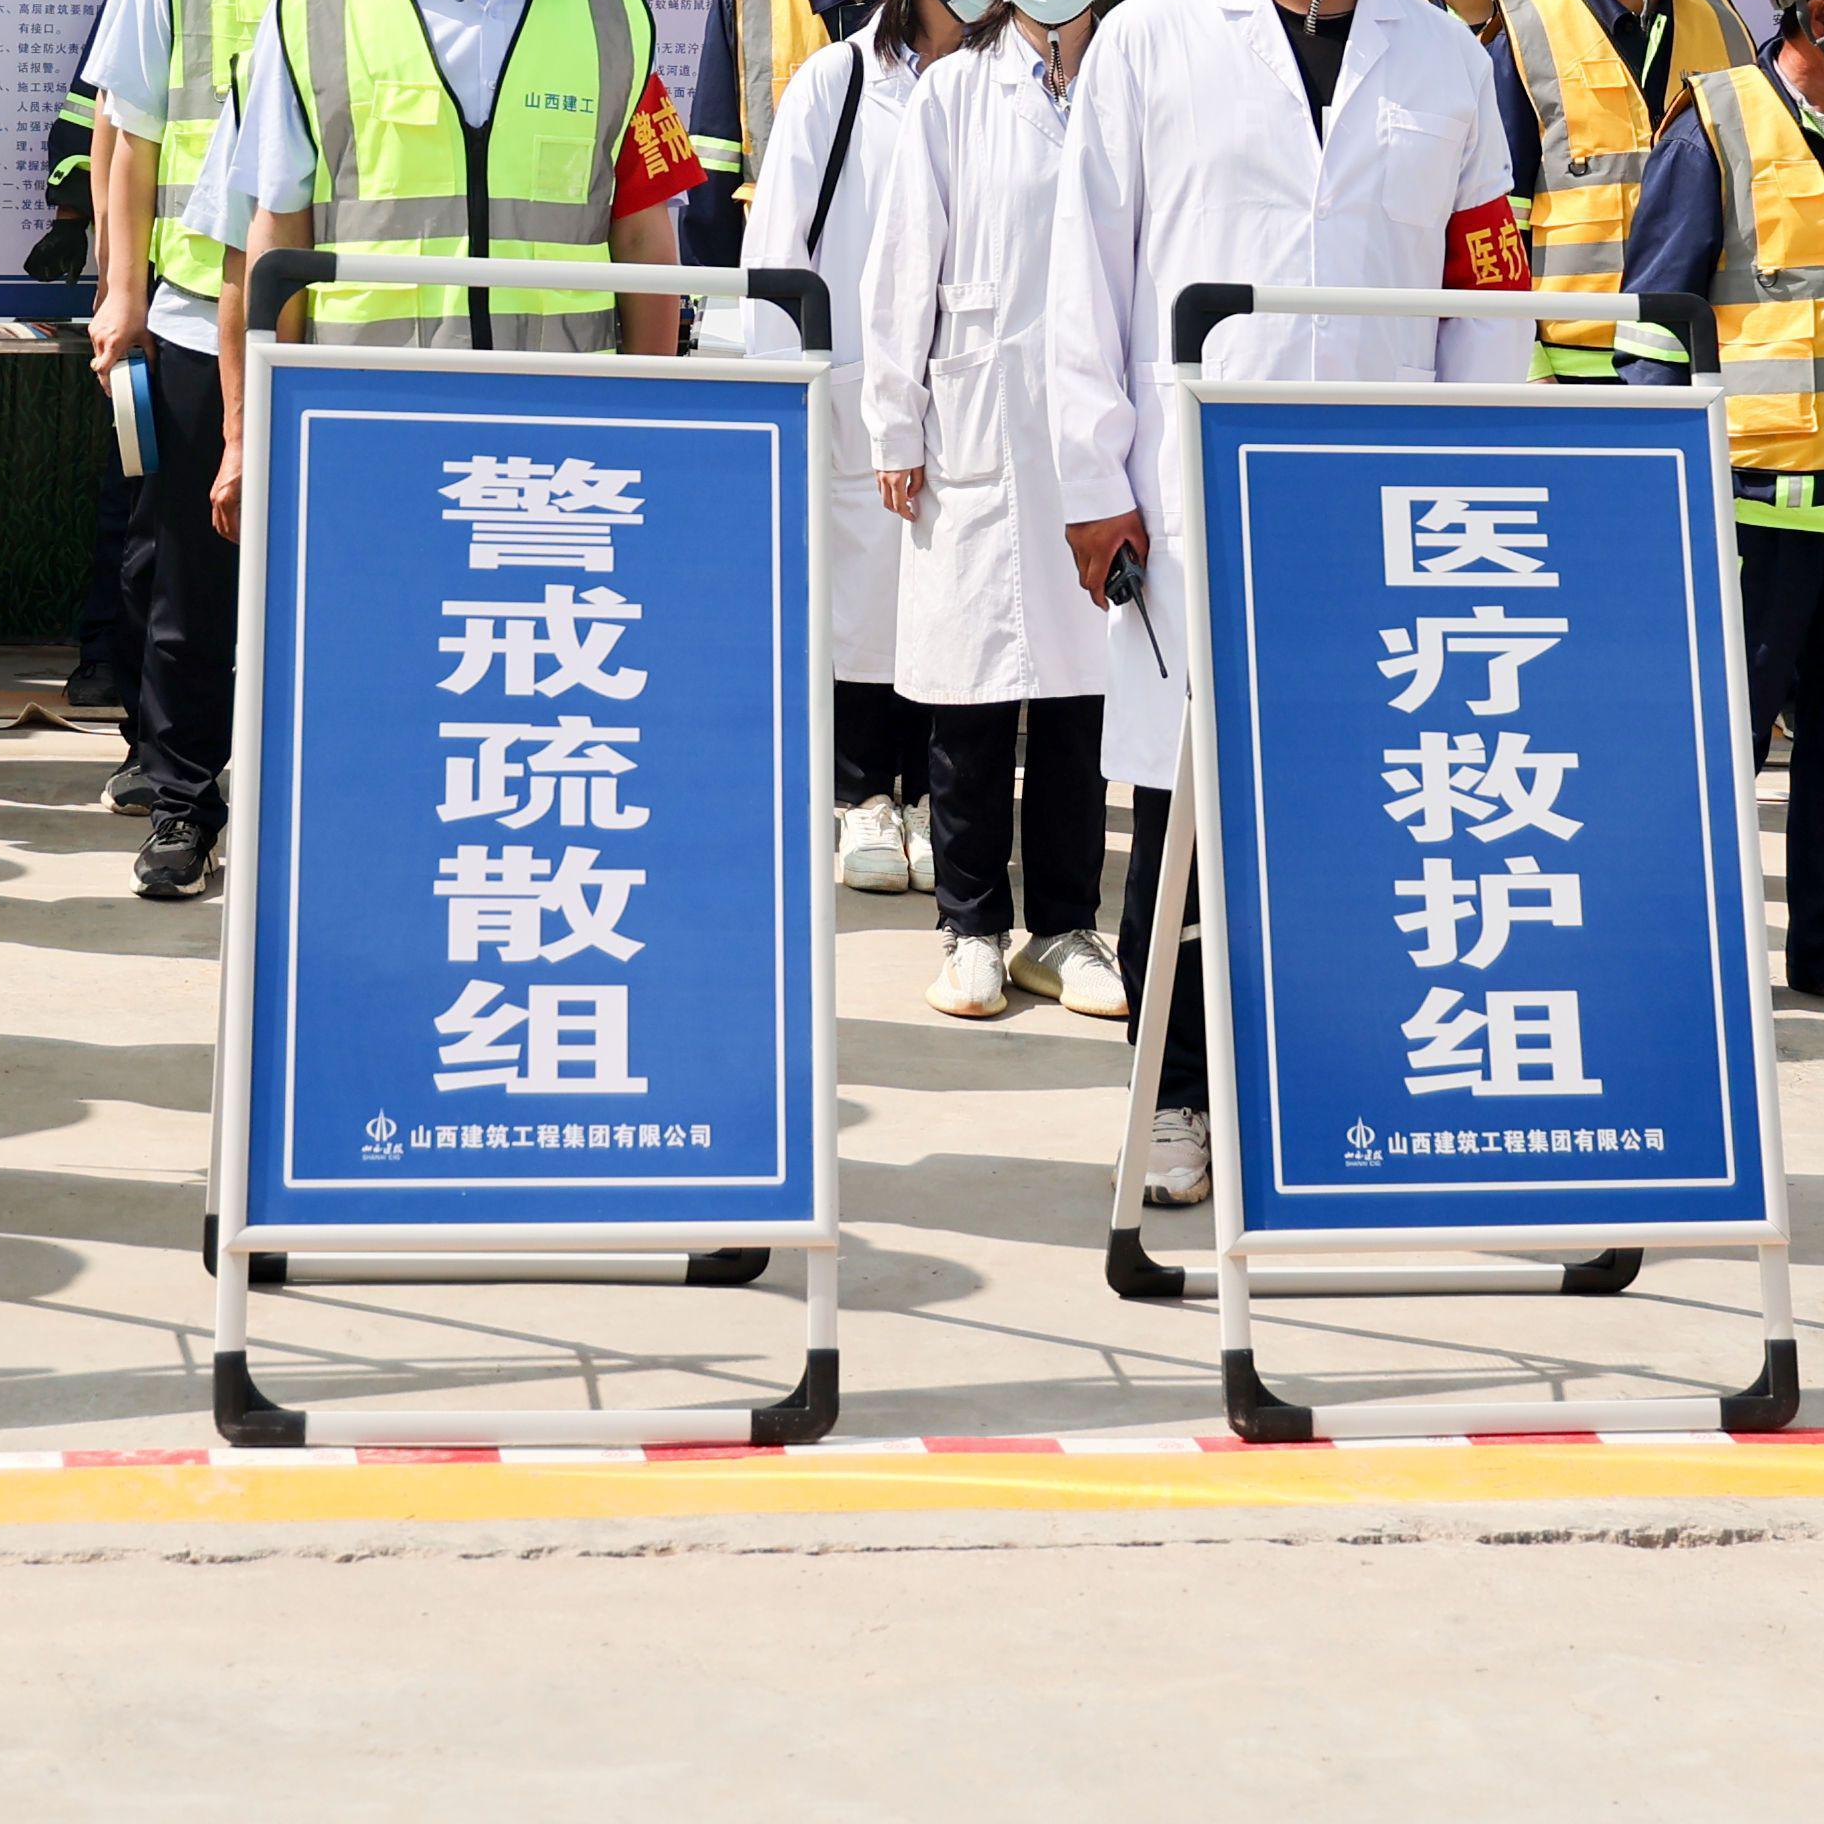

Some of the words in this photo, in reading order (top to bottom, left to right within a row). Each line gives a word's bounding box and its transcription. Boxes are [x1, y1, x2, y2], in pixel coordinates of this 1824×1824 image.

[18, 22, 62, 35] 有接口。
[657, 42, 704, 55] 无泥泞
[524, 91, 595, 114] 山西建工
[434, 455, 649, 1094] 警戒疏散组
[1377, 486, 1604, 1097] 医疗救护组
[410, 1122, 713, 1150] 山西建筑工程集团有限公司
[1388, 1128, 1665, 1155] 山西建筑工程集团有限公司
